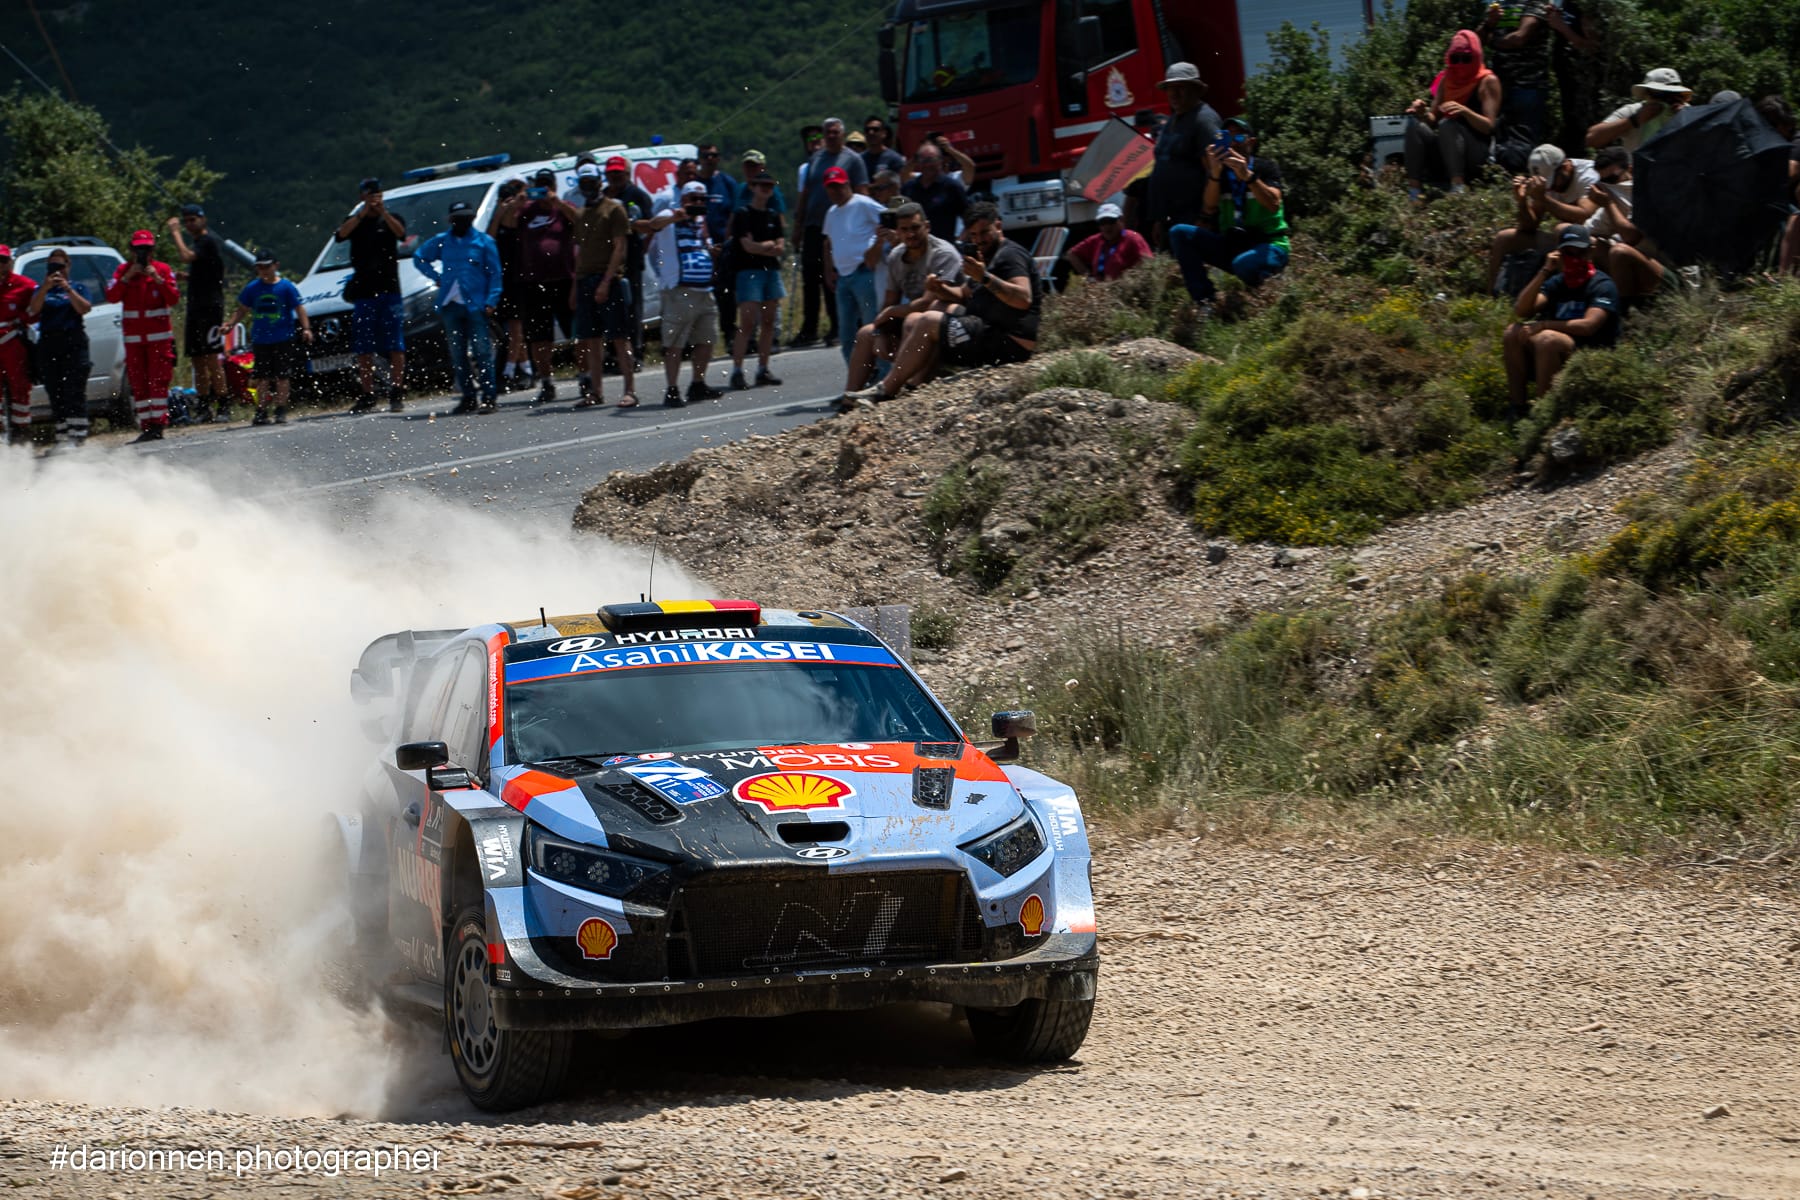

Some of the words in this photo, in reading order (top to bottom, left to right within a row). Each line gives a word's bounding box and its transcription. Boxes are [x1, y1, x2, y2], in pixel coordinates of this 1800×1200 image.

[615, 627, 755, 645] HYUNDAI
[680, 748, 804, 761] HYUNDAI
[718, 753, 901, 771] MOBIS
[1047, 812, 1065, 851] HYUNDAI
[498, 824, 514, 859] HYUNDAI
